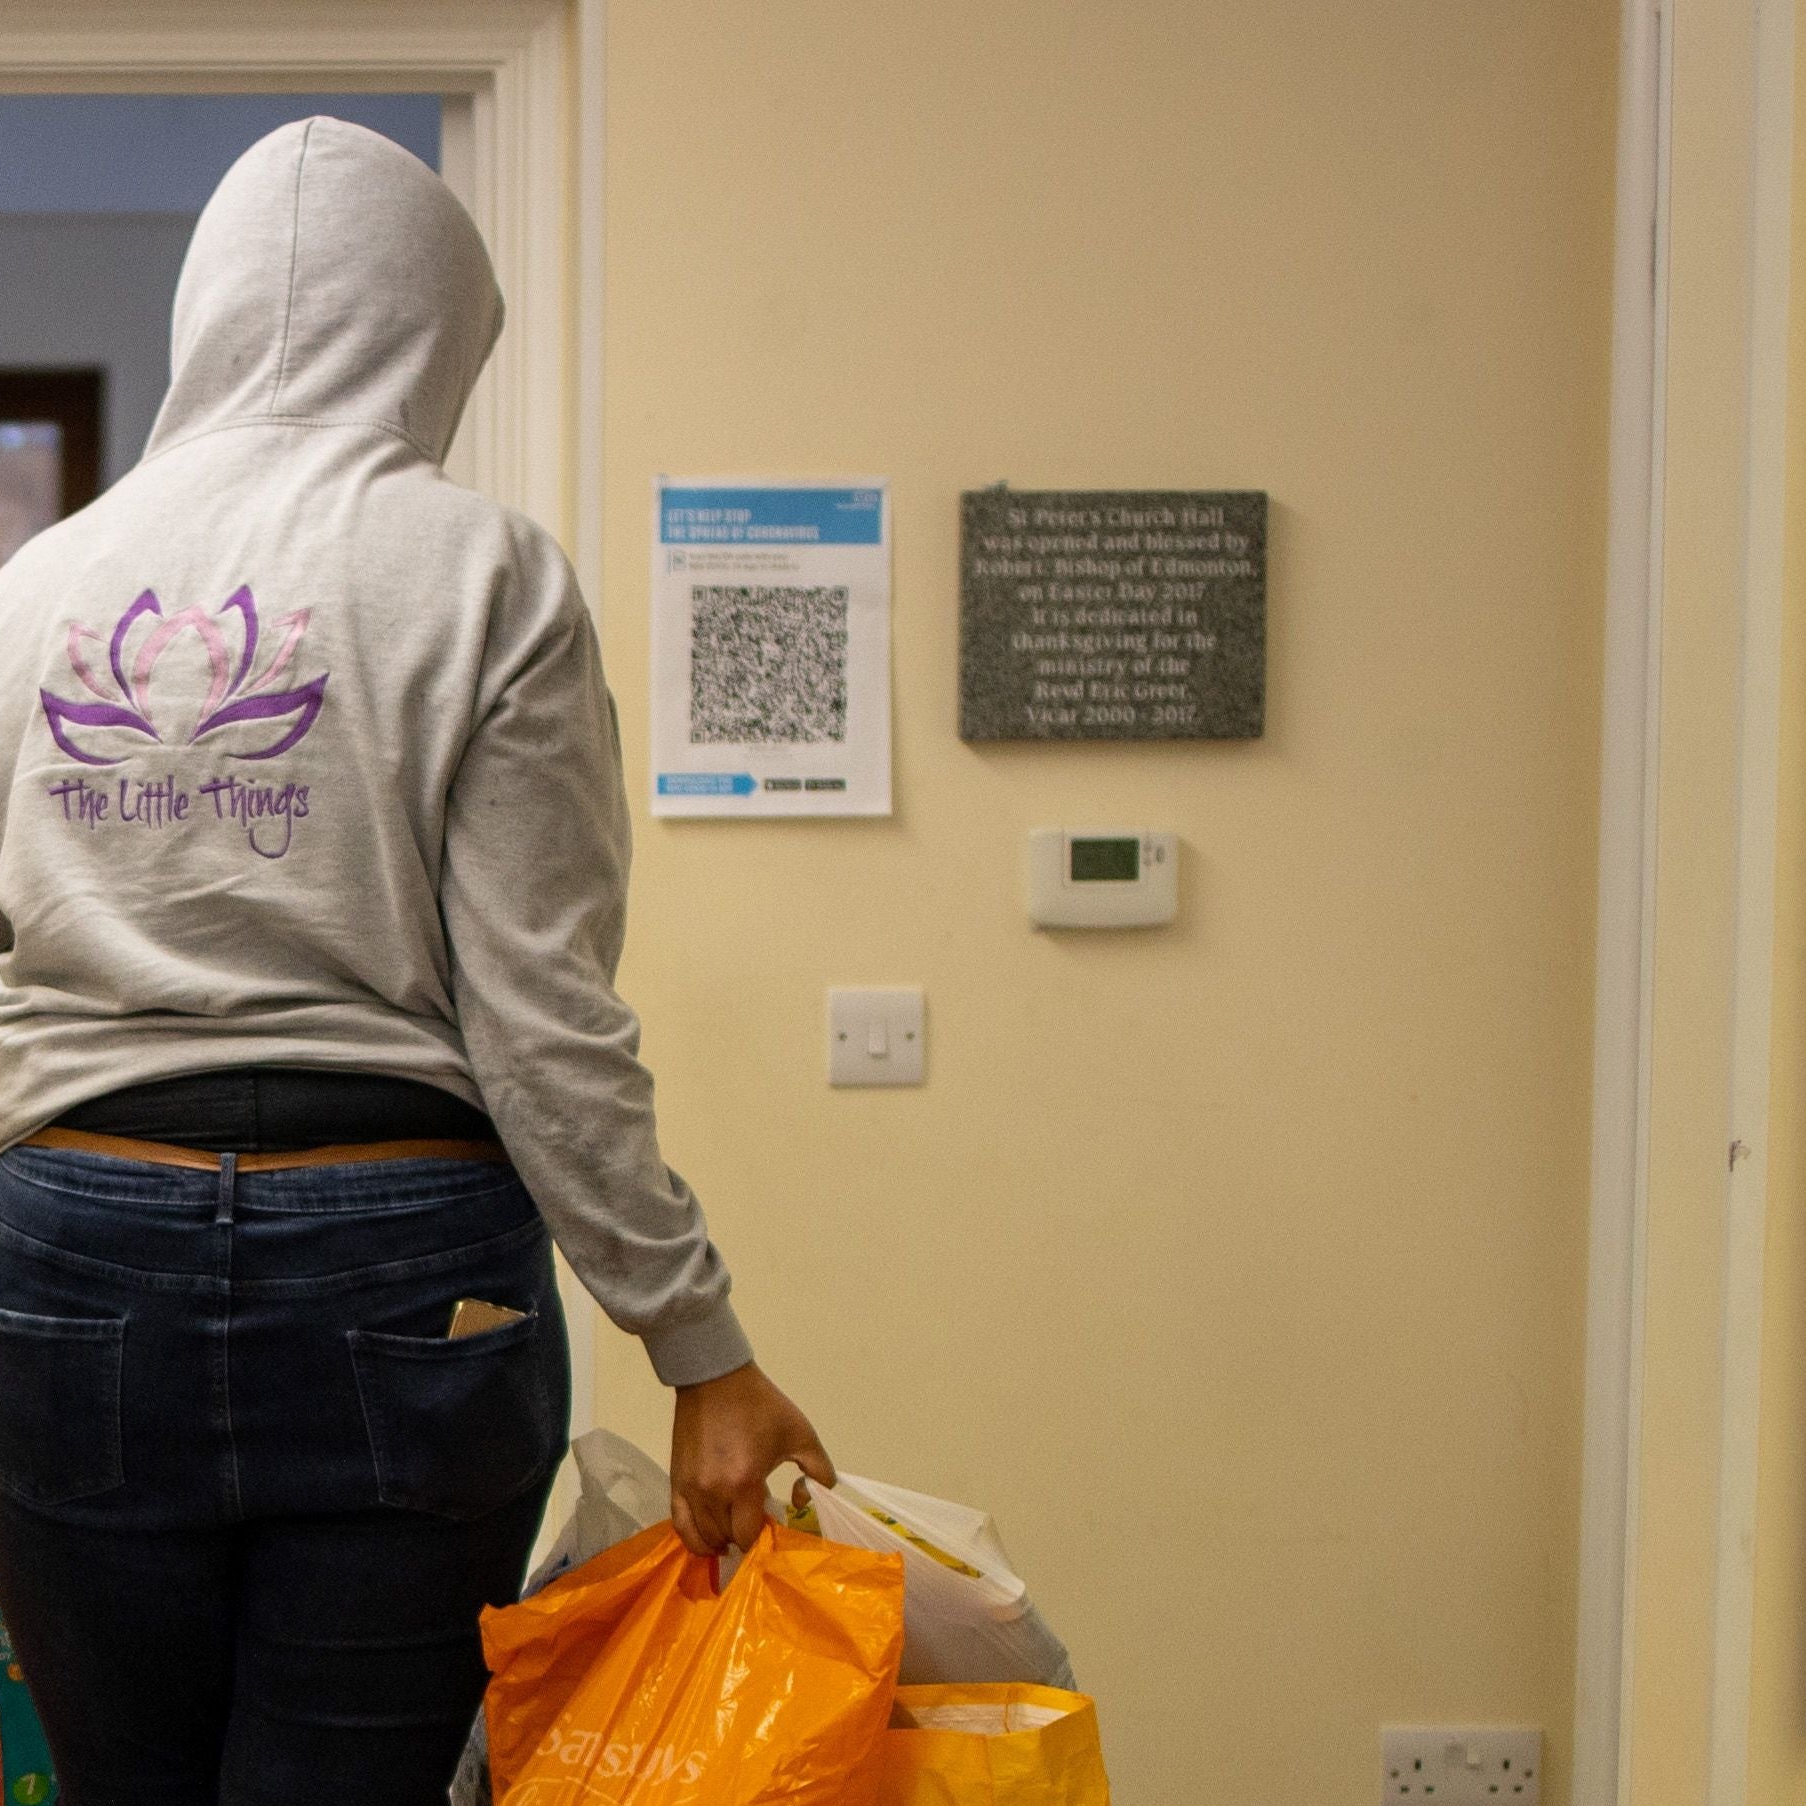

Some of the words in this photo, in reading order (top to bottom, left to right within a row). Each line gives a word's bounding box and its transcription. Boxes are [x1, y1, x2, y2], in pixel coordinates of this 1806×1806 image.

[1108, 508, 1175, 526] Church
[1182, 508, 1224, 526] Hall
[985, 536, 1023, 551] was
[1028, 533, 1098, 555] opened
[1103, 533, 1138, 550] and
[1145, 532, 1220, 550] blessed
[1225, 532, 1250, 555] by
[1055, 557, 1121, 579] Bishop
[1125, 557, 1145, 575] of
[1049, 583, 1112, 600] Easter
[1118, 582, 1157, 603] Day
[1075, 608, 1173, 625] dedicated
[1178, 608, 1198, 625] in
[1011, 632, 1147, 654] thanksgiving
[1152, 632, 1180, 649] for
[1186, 632, 1217, 649] the
[1039, 658, 1125, 680] ministry
[1133, 657, 1152, 674] of
[1159, 657, 1189, 675] the
[1036, 681, 1085, 698] Revd
[1090, 681, 1127, 698] Eric
[1025, 706, 1077, 724] Vicar
[1085, 706, 1136, 724] 2000
[48, 778, 109, 830] The
[119, 774, 188, 829] Little
[200, 777, 310, 859] Things
